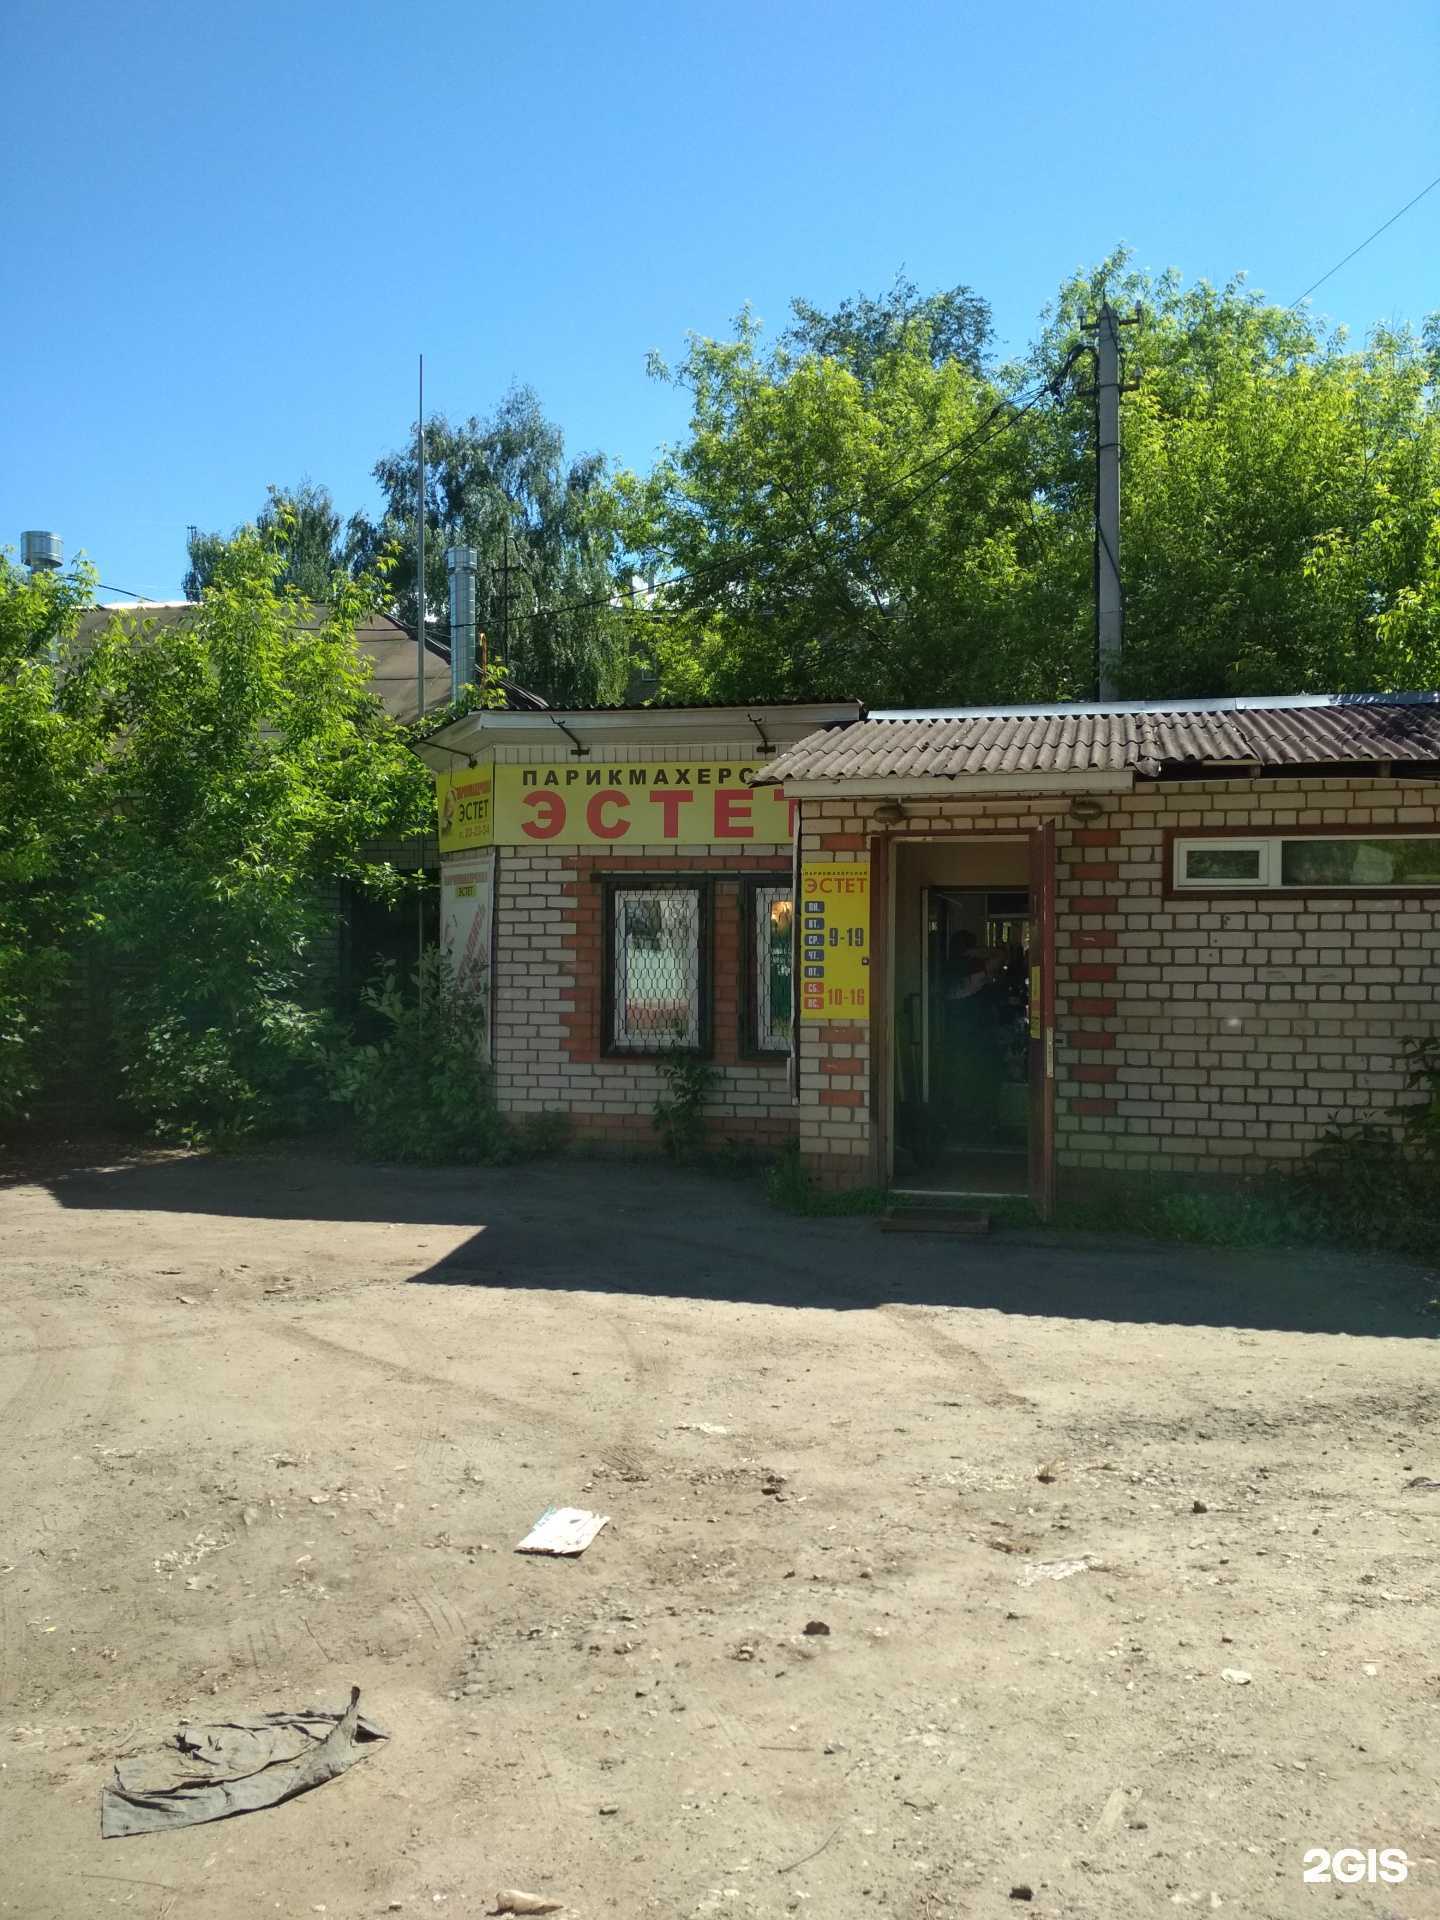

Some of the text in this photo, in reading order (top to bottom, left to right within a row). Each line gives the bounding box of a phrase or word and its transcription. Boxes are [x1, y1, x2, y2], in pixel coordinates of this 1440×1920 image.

[458, 799, 489, 822] ЭСТЕТ
[804, 877, 868, 894] ЭСТЕТ
[829, 927, 864, 947] 9-19
[827, 988, 865, 1006] 10-16
